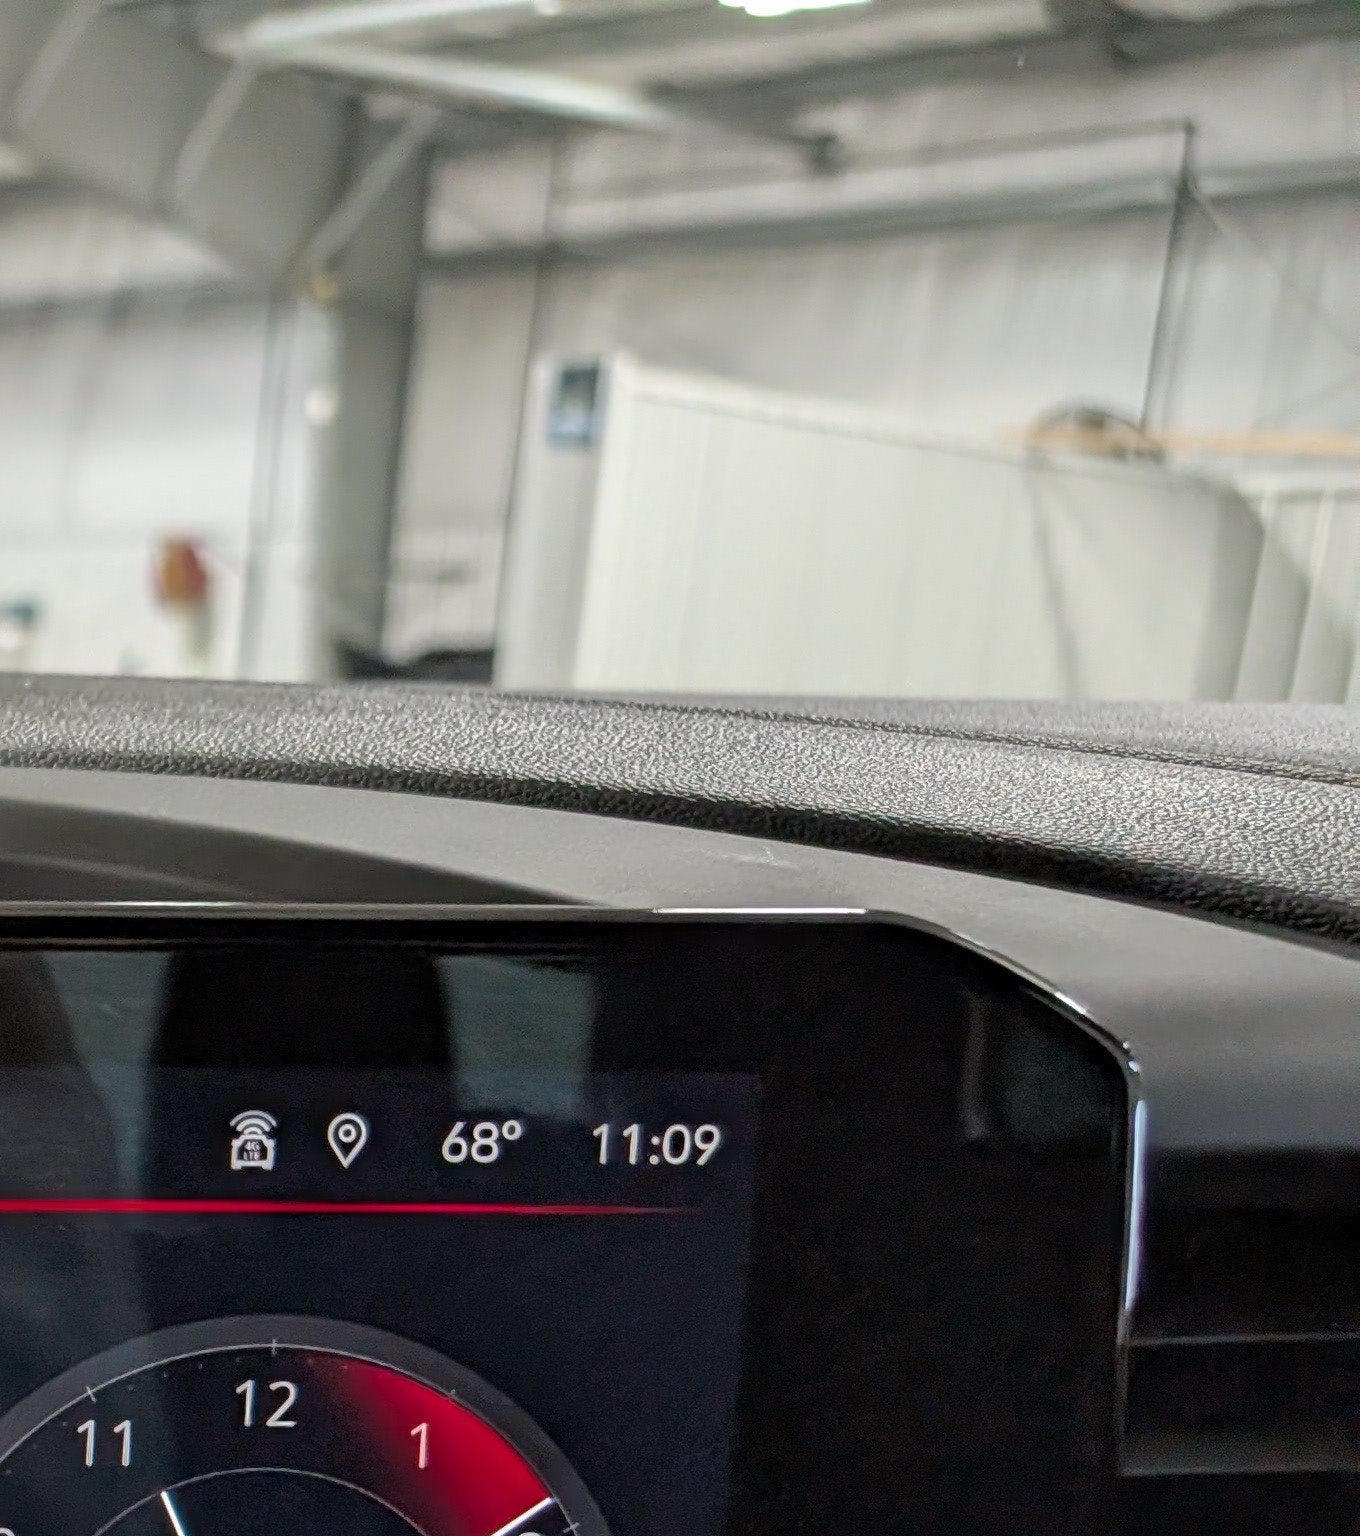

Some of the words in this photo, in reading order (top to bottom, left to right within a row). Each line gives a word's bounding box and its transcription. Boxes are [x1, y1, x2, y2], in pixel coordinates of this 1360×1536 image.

[592, 1123, 721, 1166] 11:09
[235, 1379, 298, 1428] 12
[76, 1419, 132, 1467] 11
[410, 1422, 428, 1469] 1
